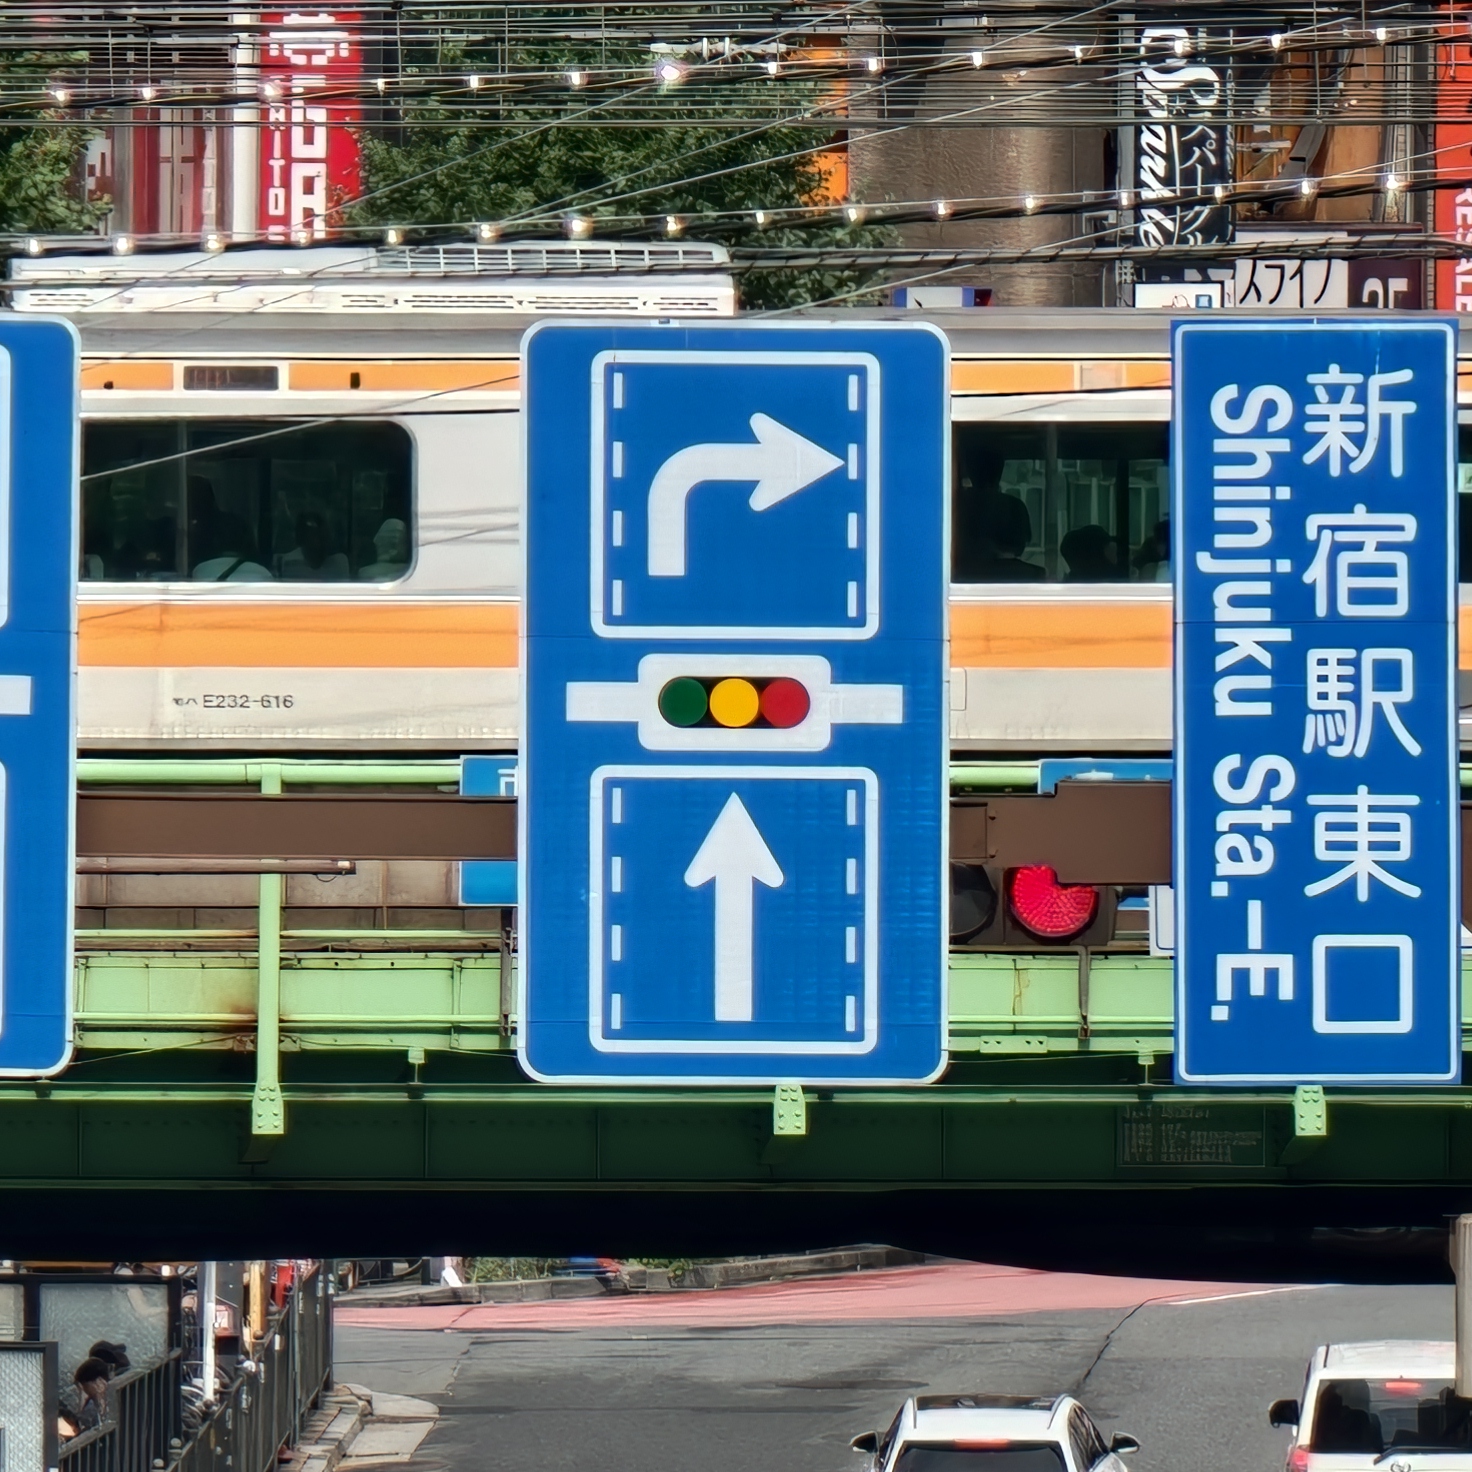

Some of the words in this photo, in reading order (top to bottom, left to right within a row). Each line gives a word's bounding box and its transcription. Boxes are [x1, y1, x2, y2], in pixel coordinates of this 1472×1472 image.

[203, 694, 294, 708] E232-616
[1196, 383, 1292, 718] Shinjuku
[1302, 362, 1422, 1034] 新宿駅東口
